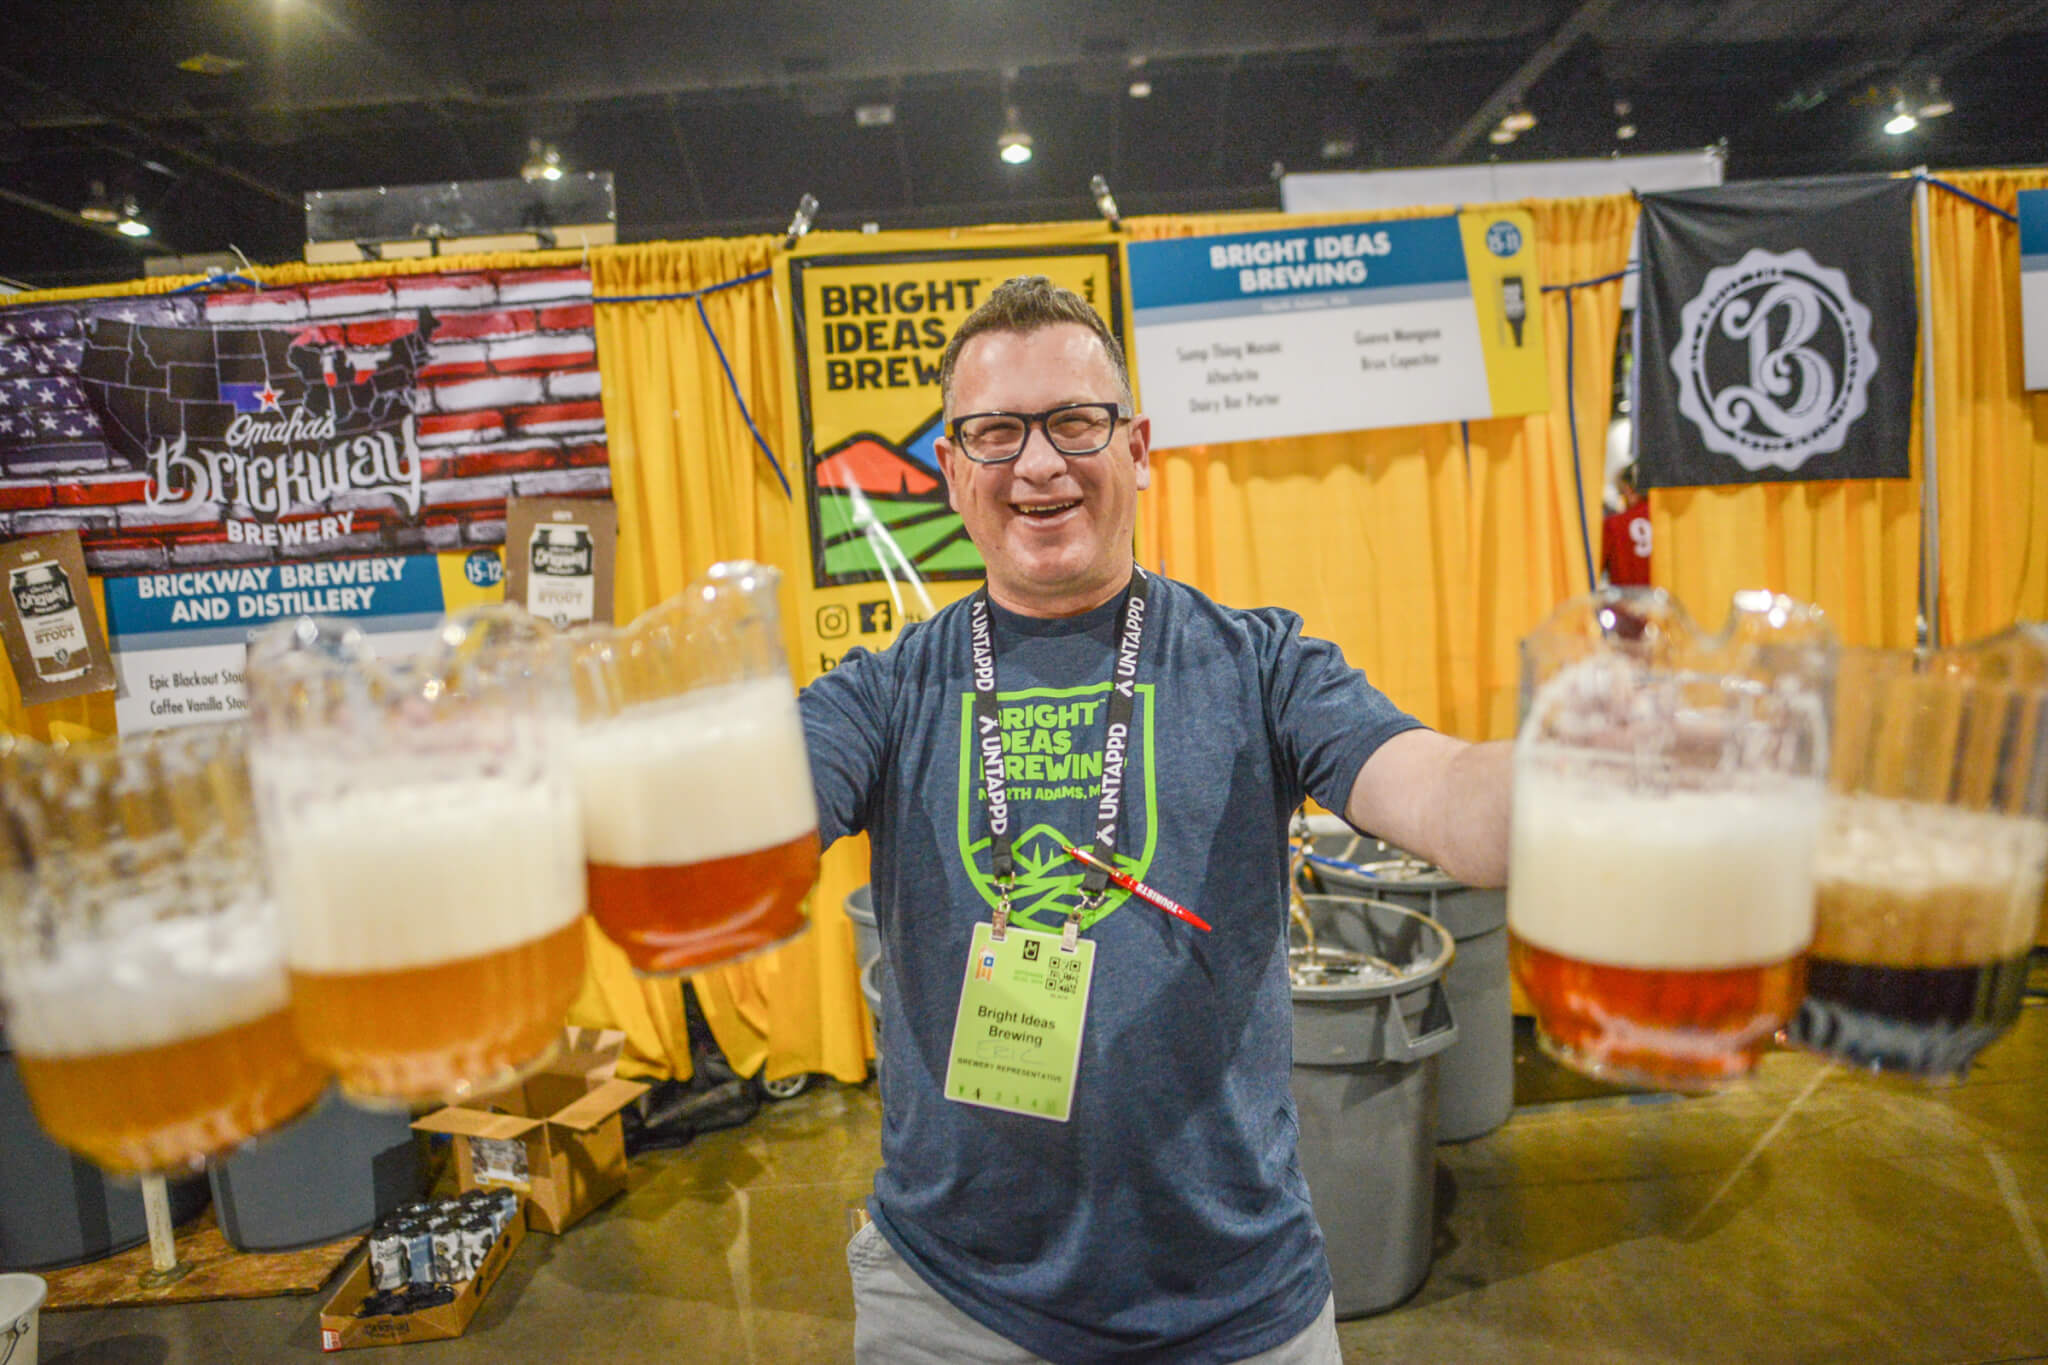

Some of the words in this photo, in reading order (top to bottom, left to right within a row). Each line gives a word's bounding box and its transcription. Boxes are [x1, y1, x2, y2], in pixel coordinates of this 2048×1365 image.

[1210, 238, 1307, 269] BRIGHT
[1314, 231, 1391, 260] IDEAS
[1239, 260, 1368, 293] BREWING
[821, 278, 981, 317] BRIGHT
[824, 318, 947, 354] IDEAS
[827, 354, 943, 391] BREW
[225, 406, 336, 448] Omaha's
[144, 414, 421, 517] Brickway
[226, 511, 354, 547] BREWERY
[138, 567, 272, 599] BRICKWAY
[280, 557, 406, 590] BREWERY
[467, 560, 503, 583] 15-12
[171, 599, 230, 623] AND
[237, 586, 375, 618] DISTILLERY
[35, 627, 75, 644] STOUT
[972, 614, 994, 691] UNTAPPD
[1117, 596, 1145, 677] UNTAPPD
[149, 674, 169, 692] Epic
[173, 670, 218, 688] Blackout
[150, 699, 184, 716] Coffee
[187, 696, 223, 712] Vanilla
[1000, 729, 1072, 755] DEAS
[979, 751, 1128, 782] REWIN
[1098, 723, 1128, 820] UNTAPPD
[978, 787, 1031, 801] NRTH
[1035, 785, 1087, 800] ADAMS,
[981, 736, 1007, 835] UNTAPPD
[977, 1005, 1017, 1024] Bright
[1021, 1013, 1056, 1030] Ideas
[989, 1025, 1043, 1048] Brewing
[957, 1057, 994, 1072] BREWERY
[996, 1064, 1063, 1084] REPRESENTATIVE
